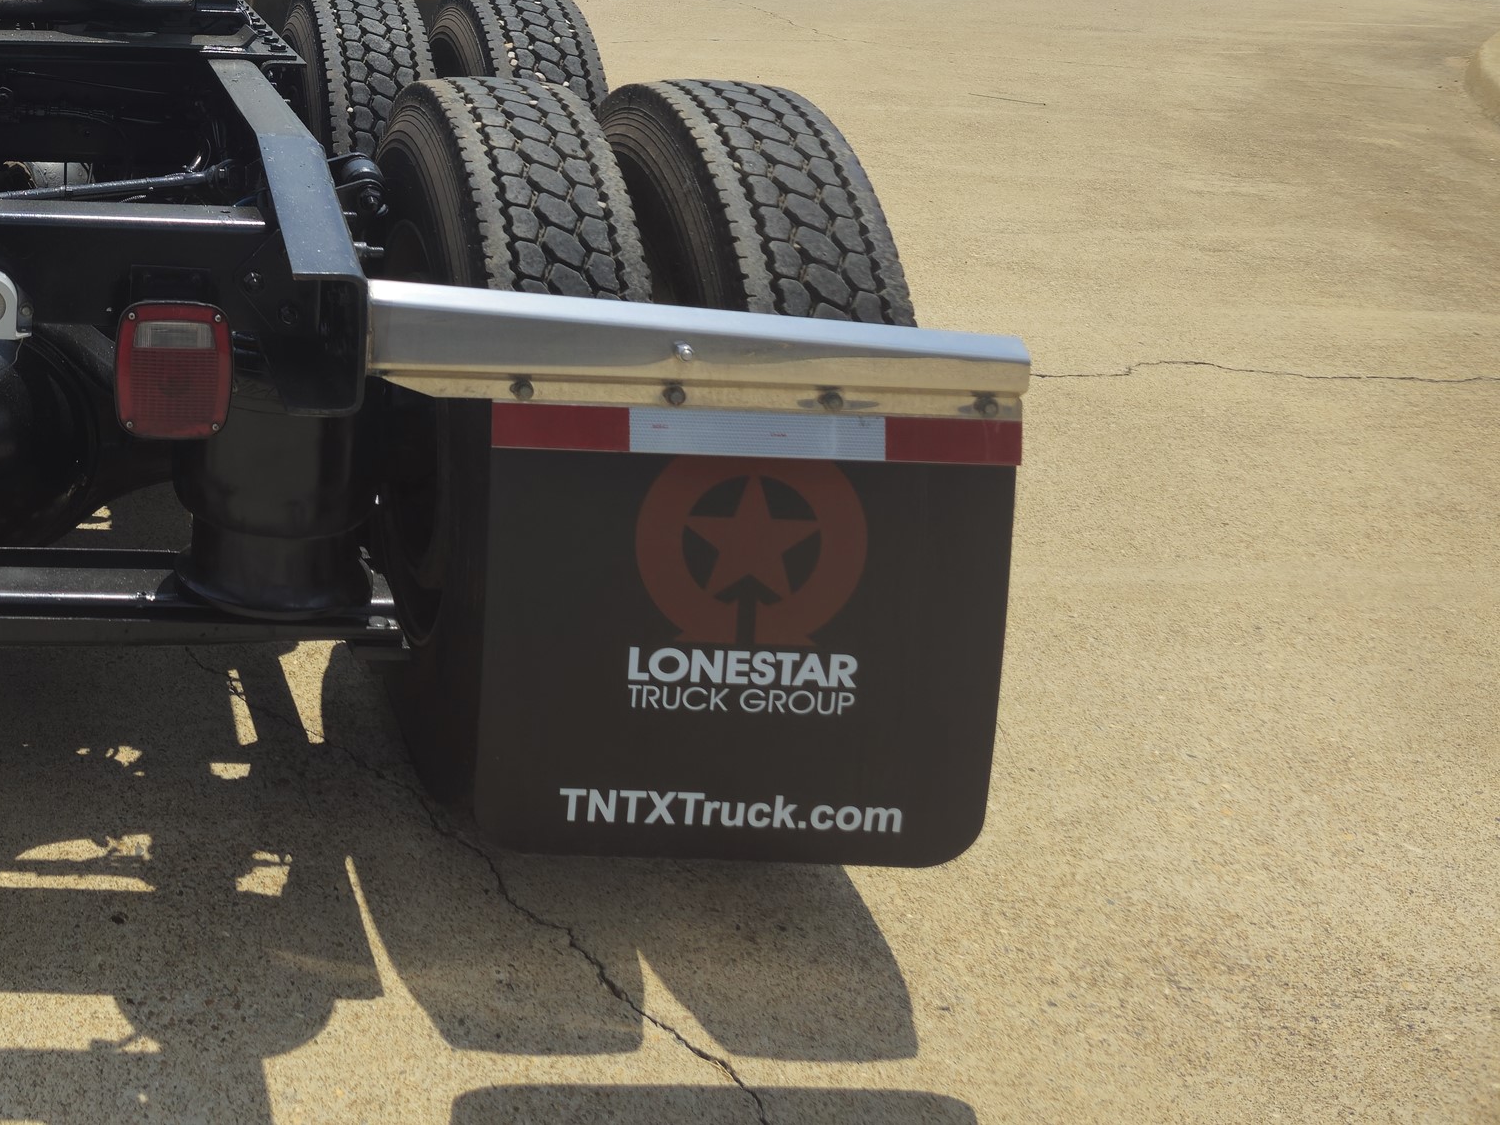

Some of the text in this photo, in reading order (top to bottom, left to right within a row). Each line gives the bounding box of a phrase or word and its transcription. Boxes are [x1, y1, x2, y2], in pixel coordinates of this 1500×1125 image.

[627, 646, 858, 688] LONESTAR
[627, 684, 855, 715] TRUCK GROUP
[559, 787, 903, 833] TNTXTruck.com
